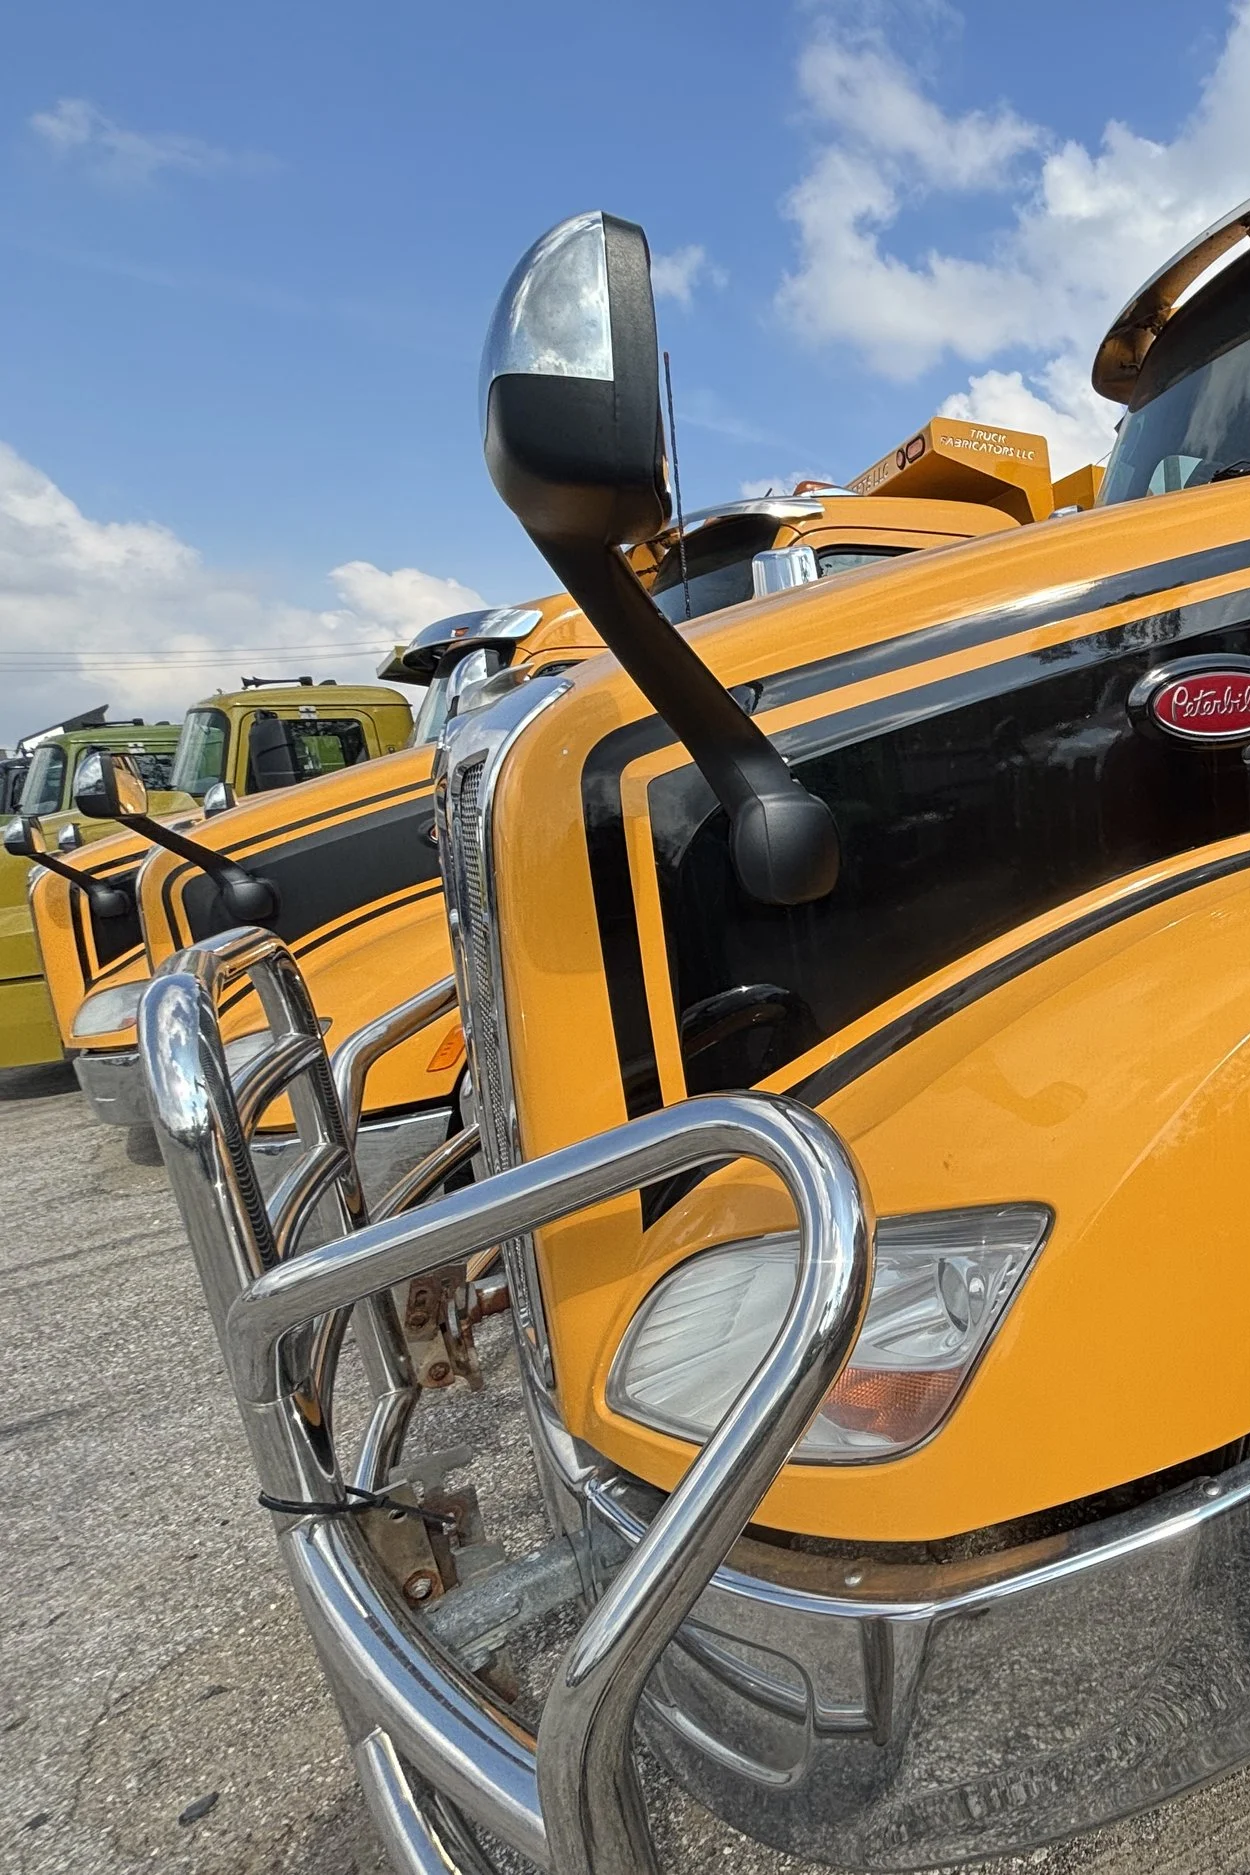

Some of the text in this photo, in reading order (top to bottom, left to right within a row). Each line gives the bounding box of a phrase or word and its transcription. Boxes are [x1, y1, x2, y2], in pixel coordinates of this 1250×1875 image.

[970, 429, 1007, 444] TRUCK
[940, 435, 1035, 461] FABRICATORS LLC
